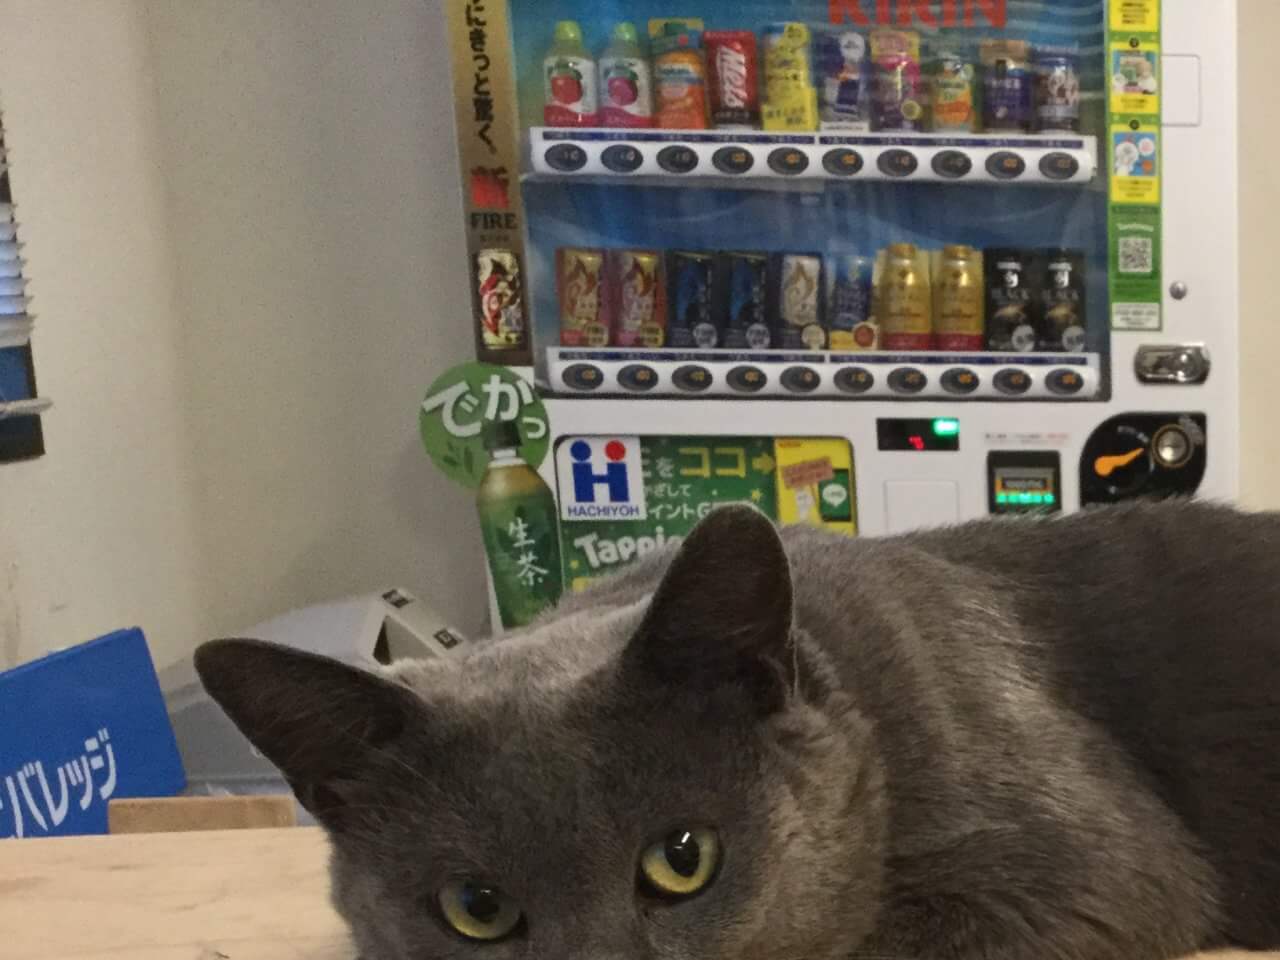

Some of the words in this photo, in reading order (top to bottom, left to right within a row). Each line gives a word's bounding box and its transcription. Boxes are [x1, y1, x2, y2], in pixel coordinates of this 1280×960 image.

[829, 0, 1007, 30] KIRIN
[471, 212, 518, 230] FIRE
[422, 374, 546, 438] でかっ
[567, 505, 640, 518] HACHIYOH
[648, 502, 713, 520] イントG
[508, 516, 550, 587] 生茶
[0, 727, 117, 839] バレッジ
